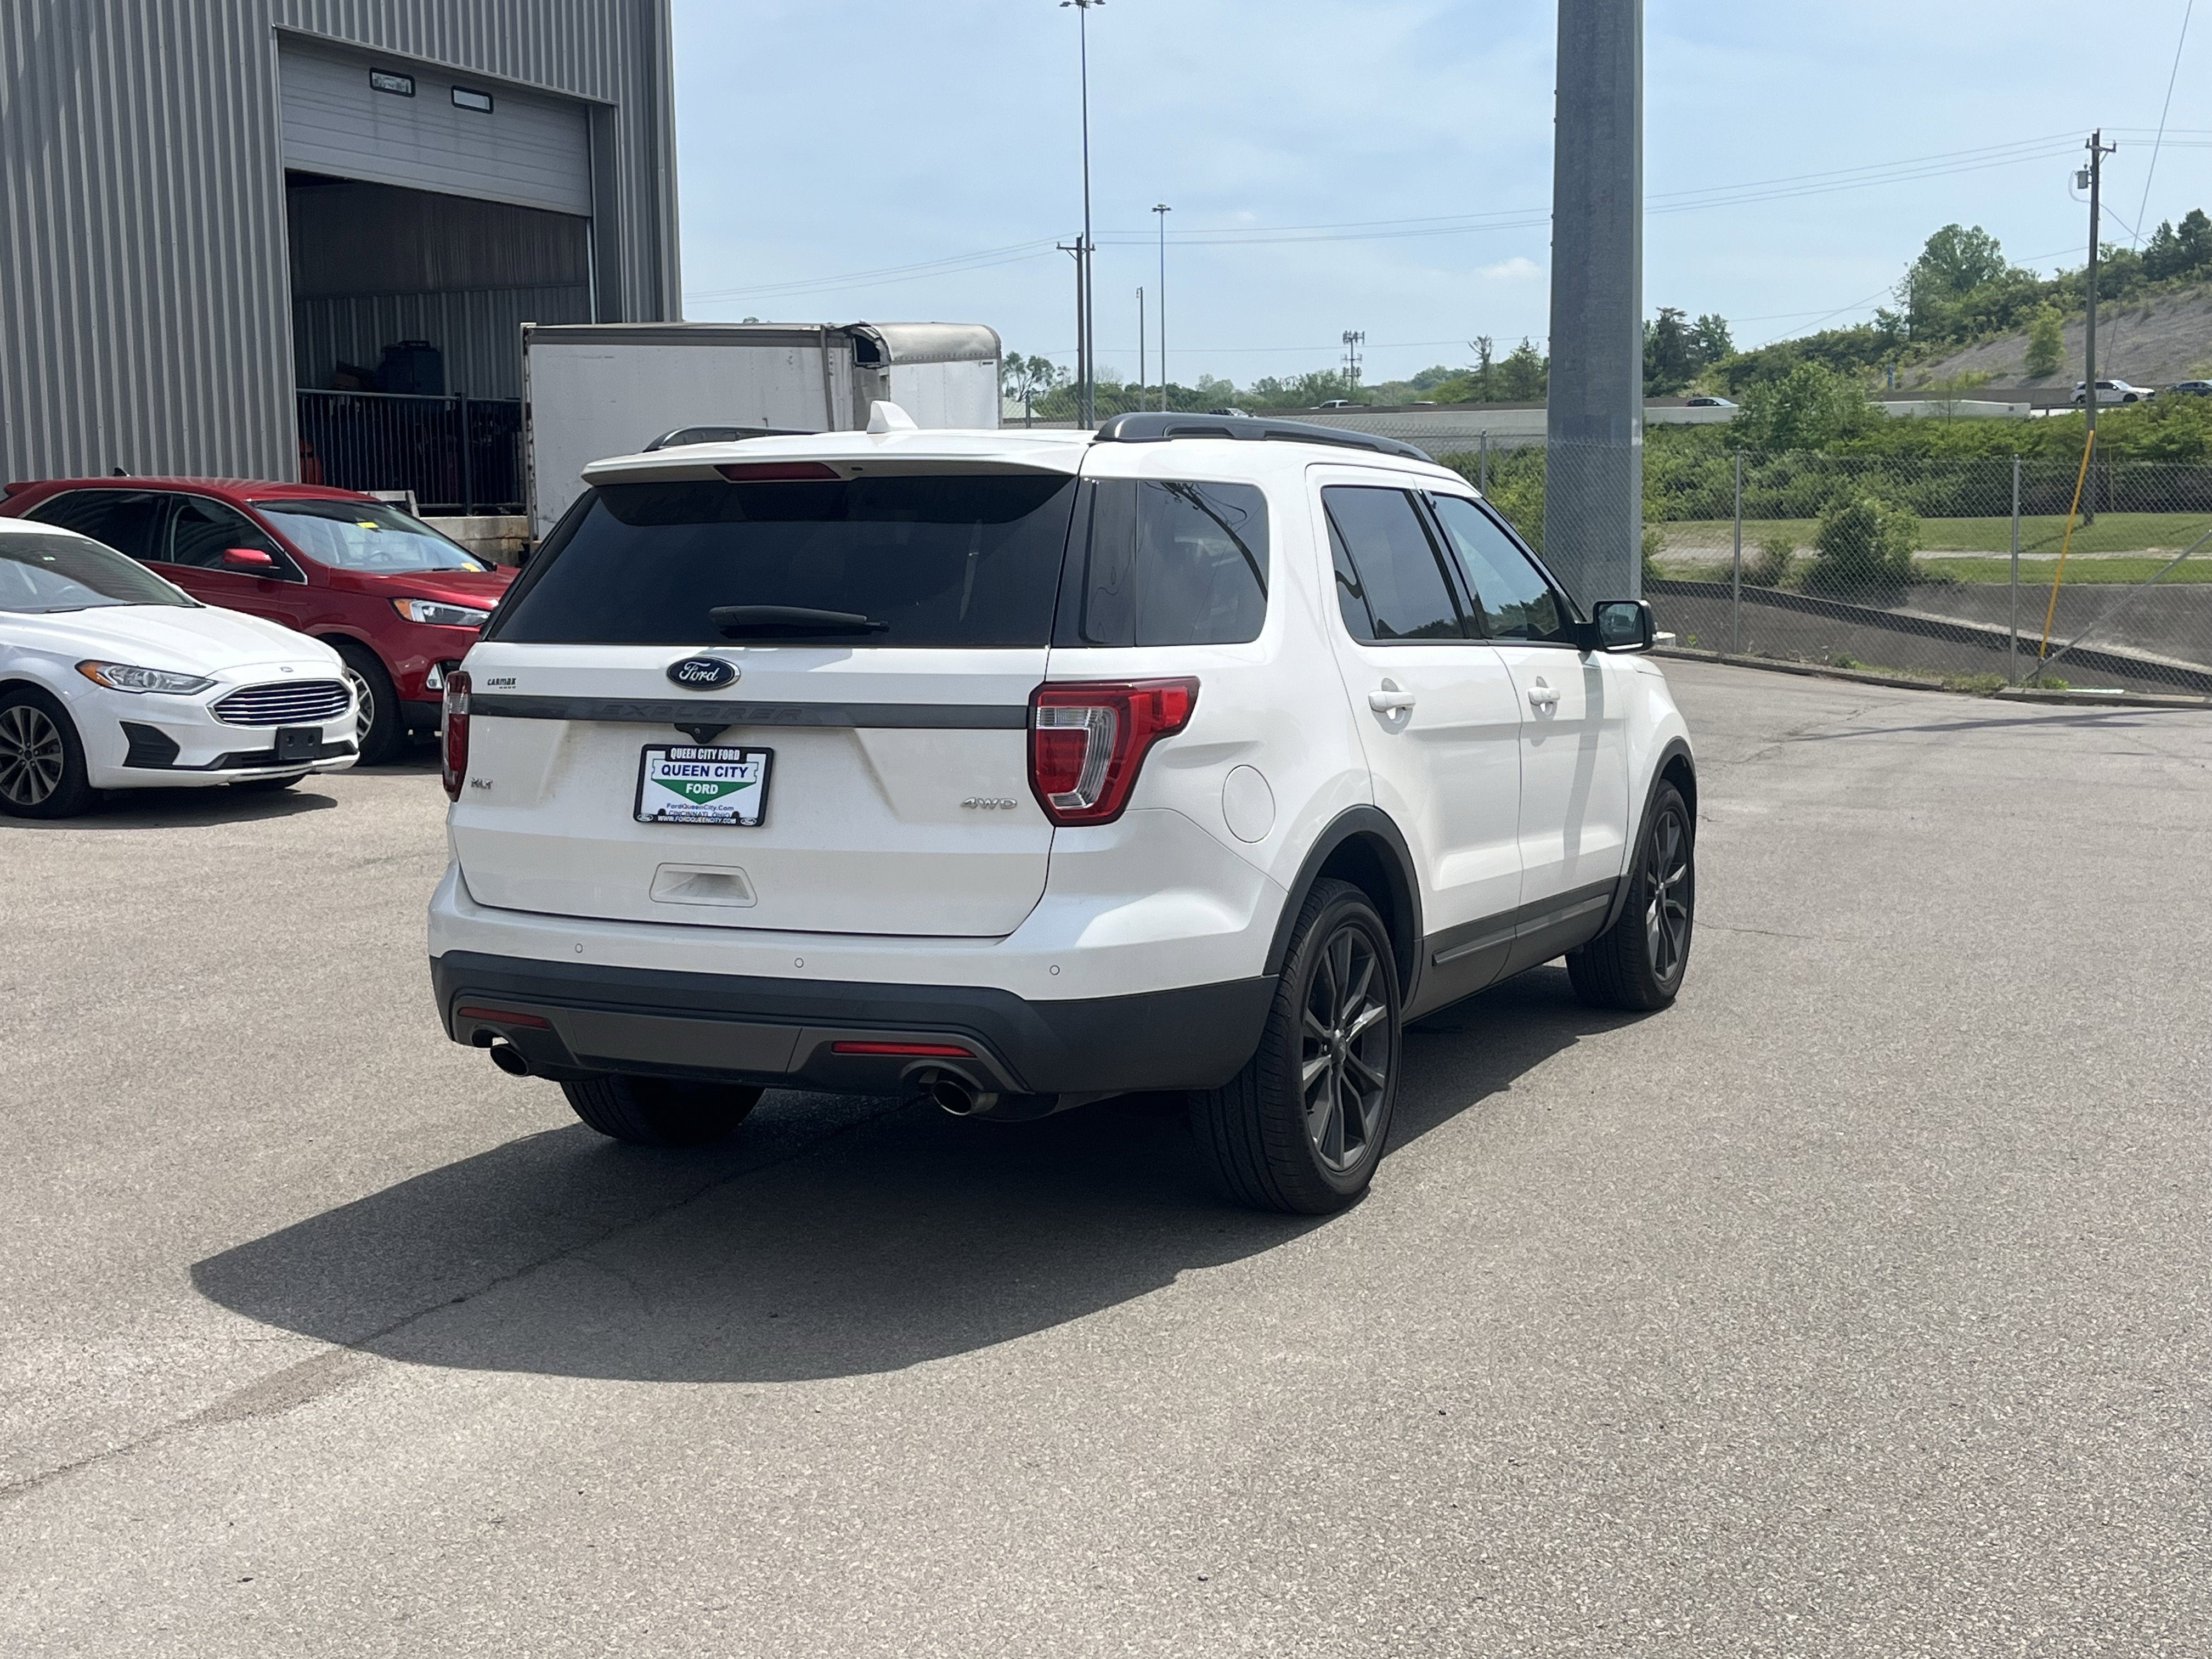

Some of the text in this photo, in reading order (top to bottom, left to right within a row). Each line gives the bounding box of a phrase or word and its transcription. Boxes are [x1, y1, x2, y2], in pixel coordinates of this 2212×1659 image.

[679, 661, 720, 682] Ford
[601, 704, 802, 721] EXPLORER
[671, 748, 741, 761] QUEEN CITY FORD
[661, 764, 749, 778] QUEEN CITY
[471, 777, 494, 790] XLT
[686, 783, 719, 794] FORD
[961, 797, 1018, 810] 4WD
